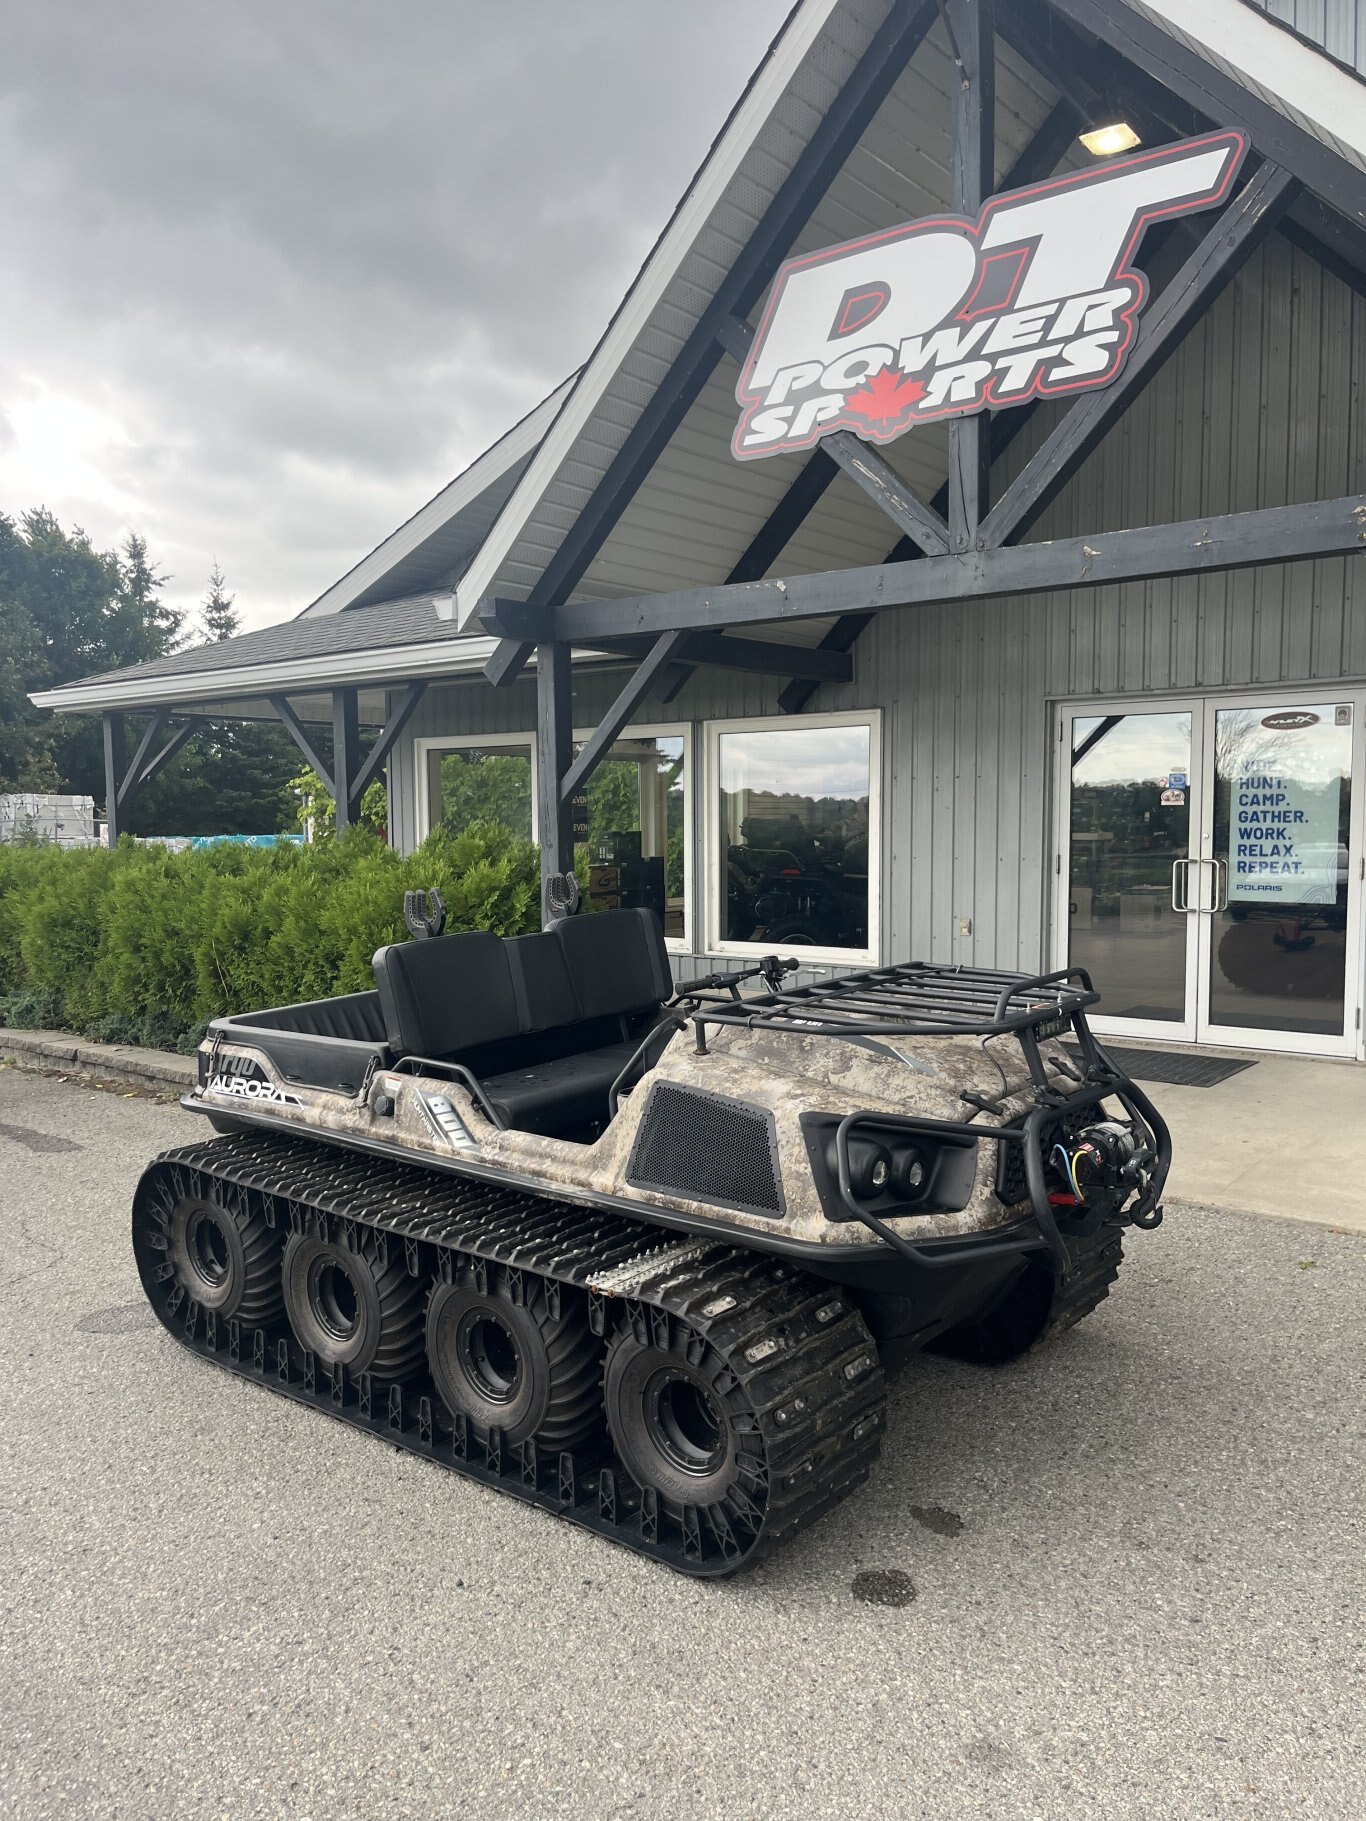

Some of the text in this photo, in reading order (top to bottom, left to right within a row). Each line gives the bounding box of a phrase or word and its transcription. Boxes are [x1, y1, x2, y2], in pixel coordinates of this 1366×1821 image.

[749, 146, 1231, 389] DT
[768, 287, 1131, 405] POWER
[743, 330, 1119, 446] SPRTS
[1239, 777, 1287, 790] HUNT.
[1238, 793, 1290, 806] CAMP.
[1238, 810, 1309, 823] GATHER.
[1238, 827, 1292, 840] WORK.
[1237, 844, 1299, 857] RELAX.
[1236, 861, 1305, 875] REPEAT.
[205, 1075, 287, 1105] AURORA
[427, 1096, 473, 1148] 800
